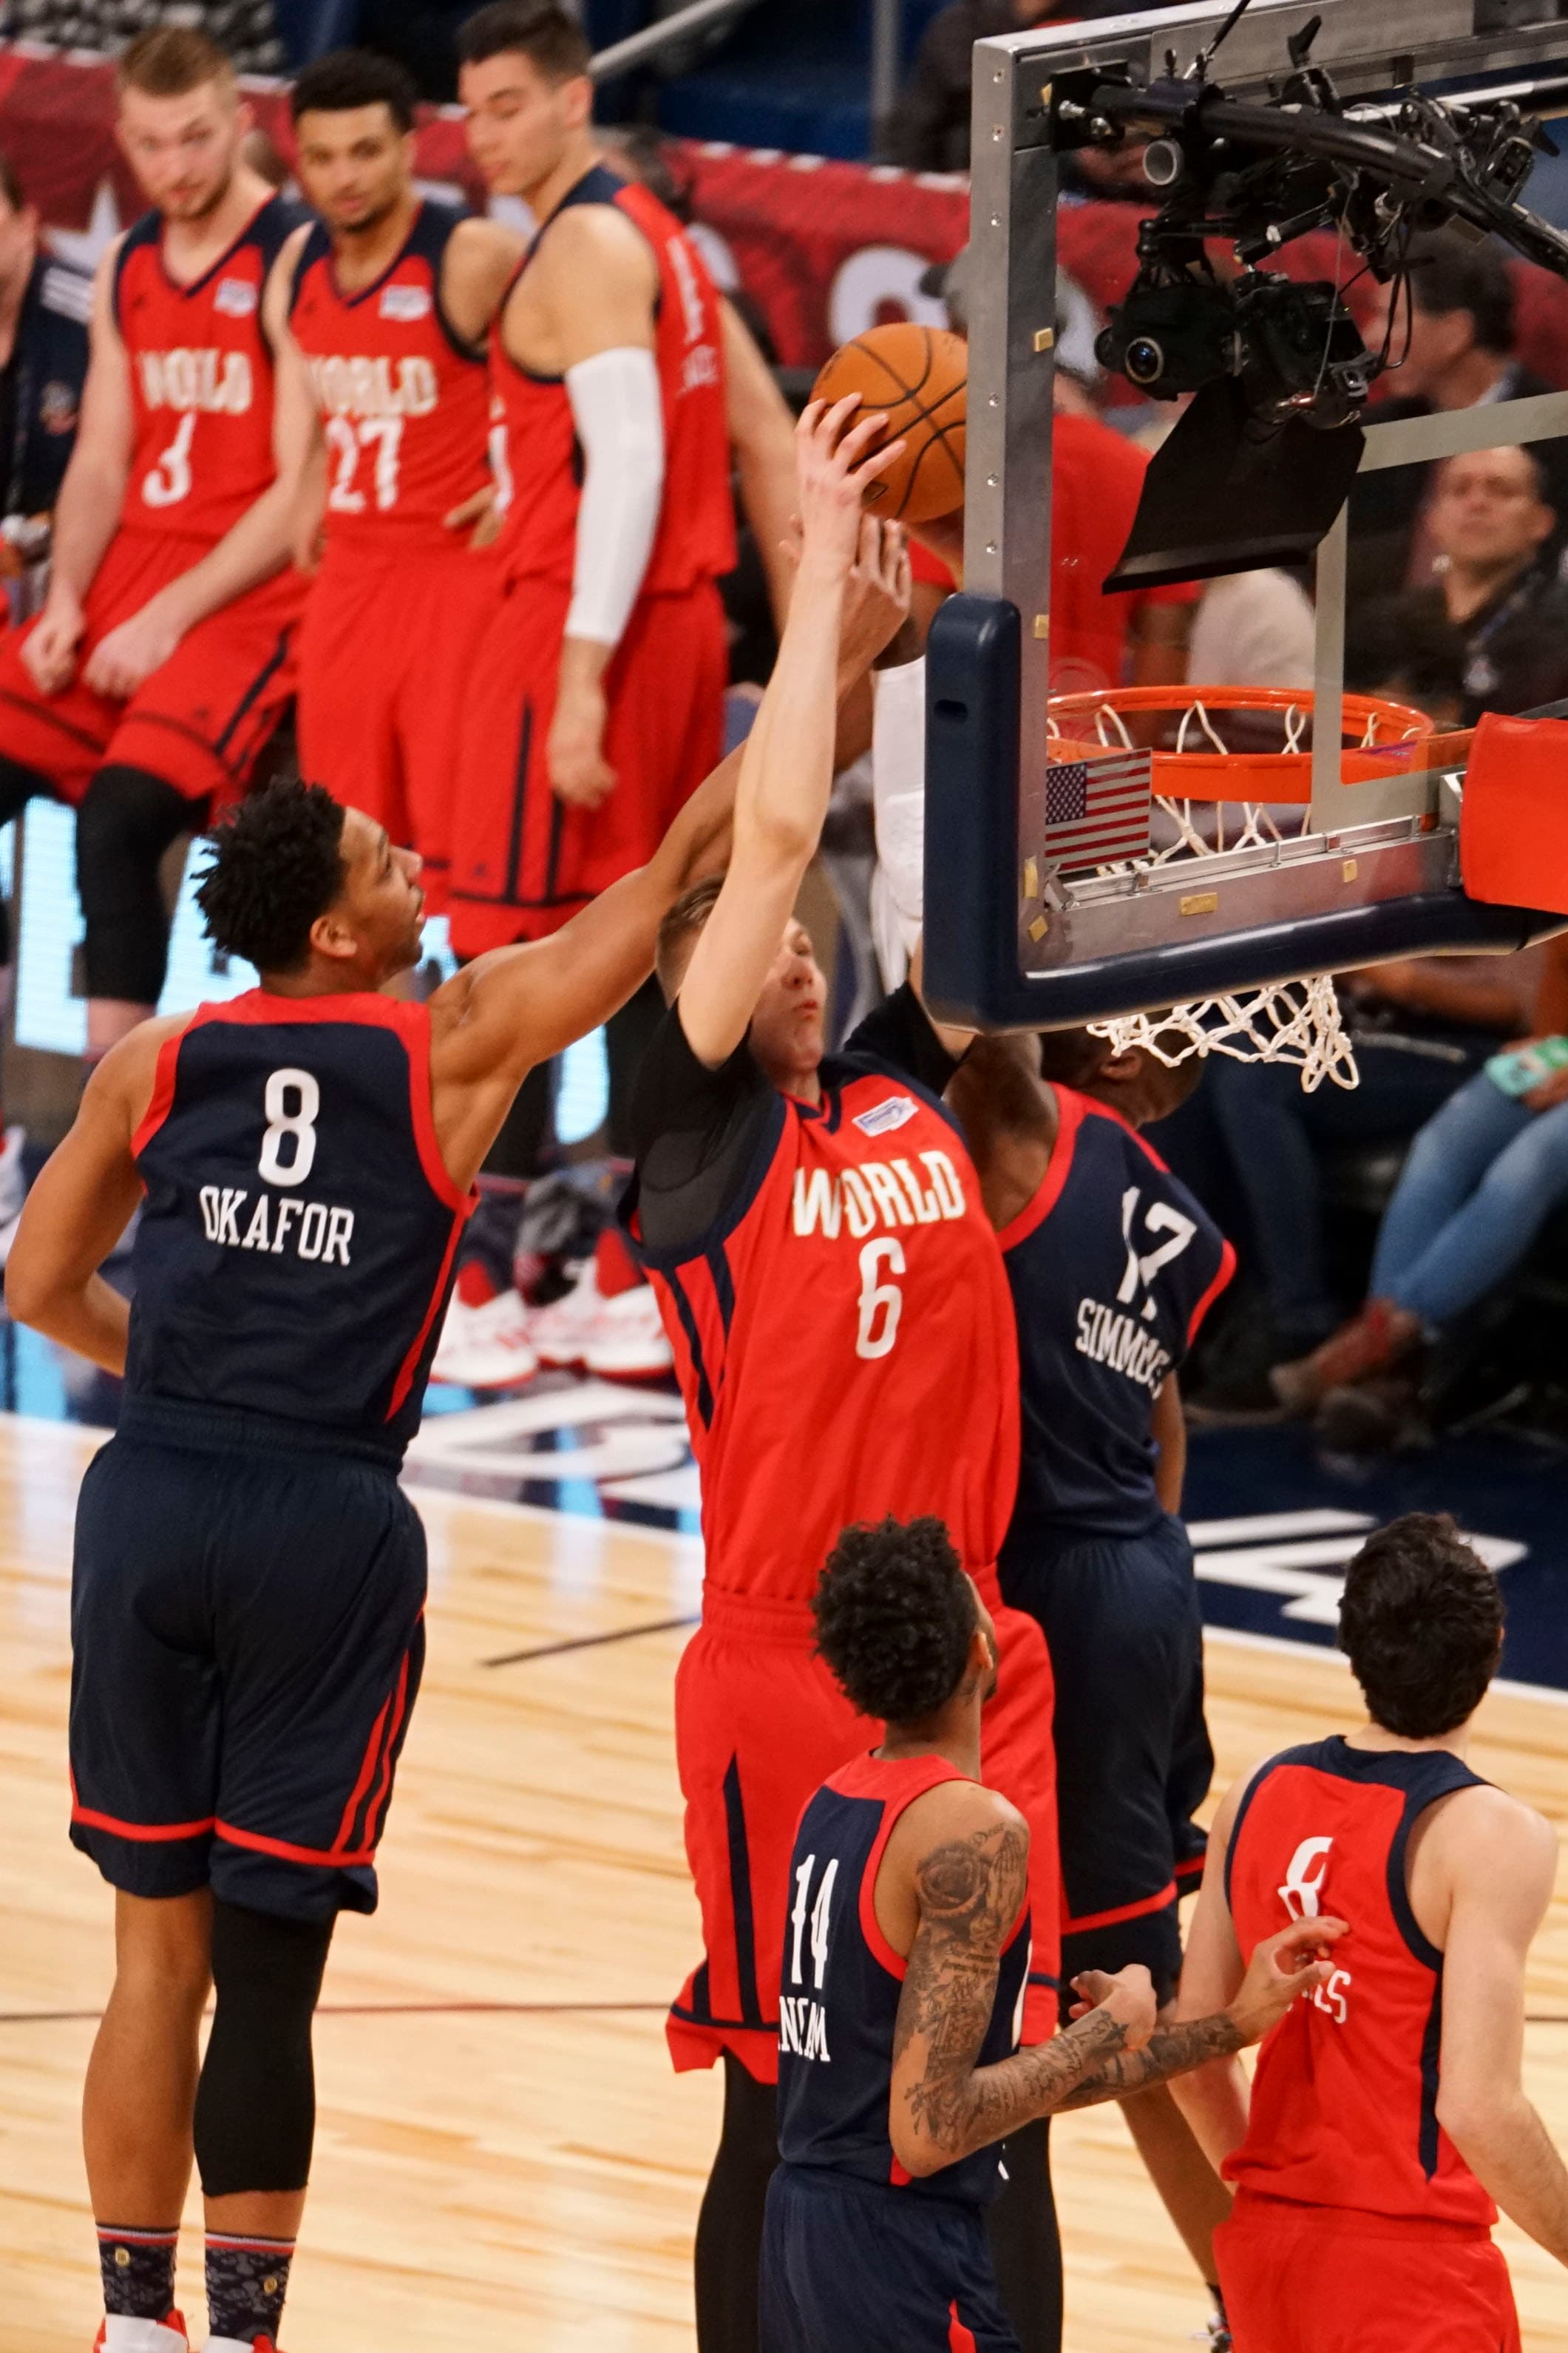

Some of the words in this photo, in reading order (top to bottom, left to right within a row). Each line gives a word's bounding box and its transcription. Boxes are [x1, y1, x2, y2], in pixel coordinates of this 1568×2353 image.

[325, 416, 405, 514] 27
[259, 1068, 319, 1187] 8
[199, 1185, 355, 1267] OKAFOR
[793, 1149, 967, 1240] WORLD
[855, 1236, 906, 1360] 6
[791, 1853, 839, 1990] 14
[778, 1996, 831, 2062] NAM
